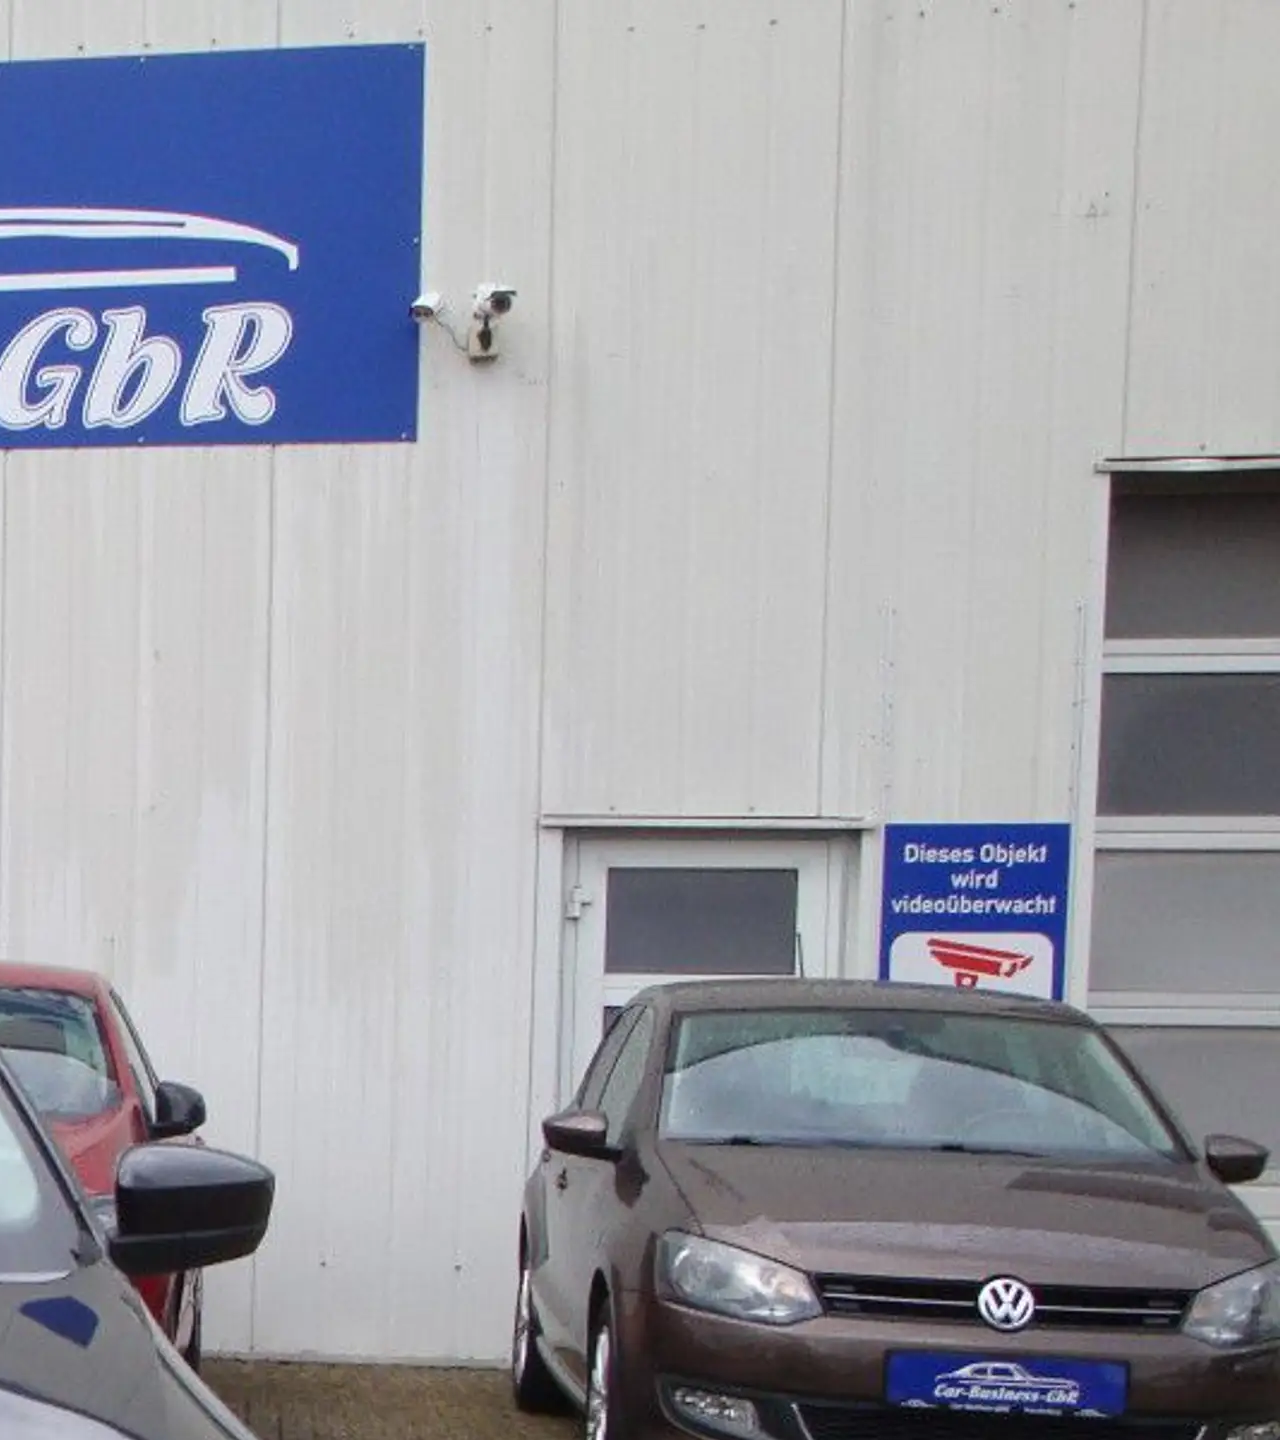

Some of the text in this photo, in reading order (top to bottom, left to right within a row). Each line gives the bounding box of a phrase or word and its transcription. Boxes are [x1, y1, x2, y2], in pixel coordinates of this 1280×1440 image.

[904, 844, 1047, 867] Dieses Objekt
[950, 870, 999, 889] wird
[891, 894, 1057, 915] videoüberwacht
